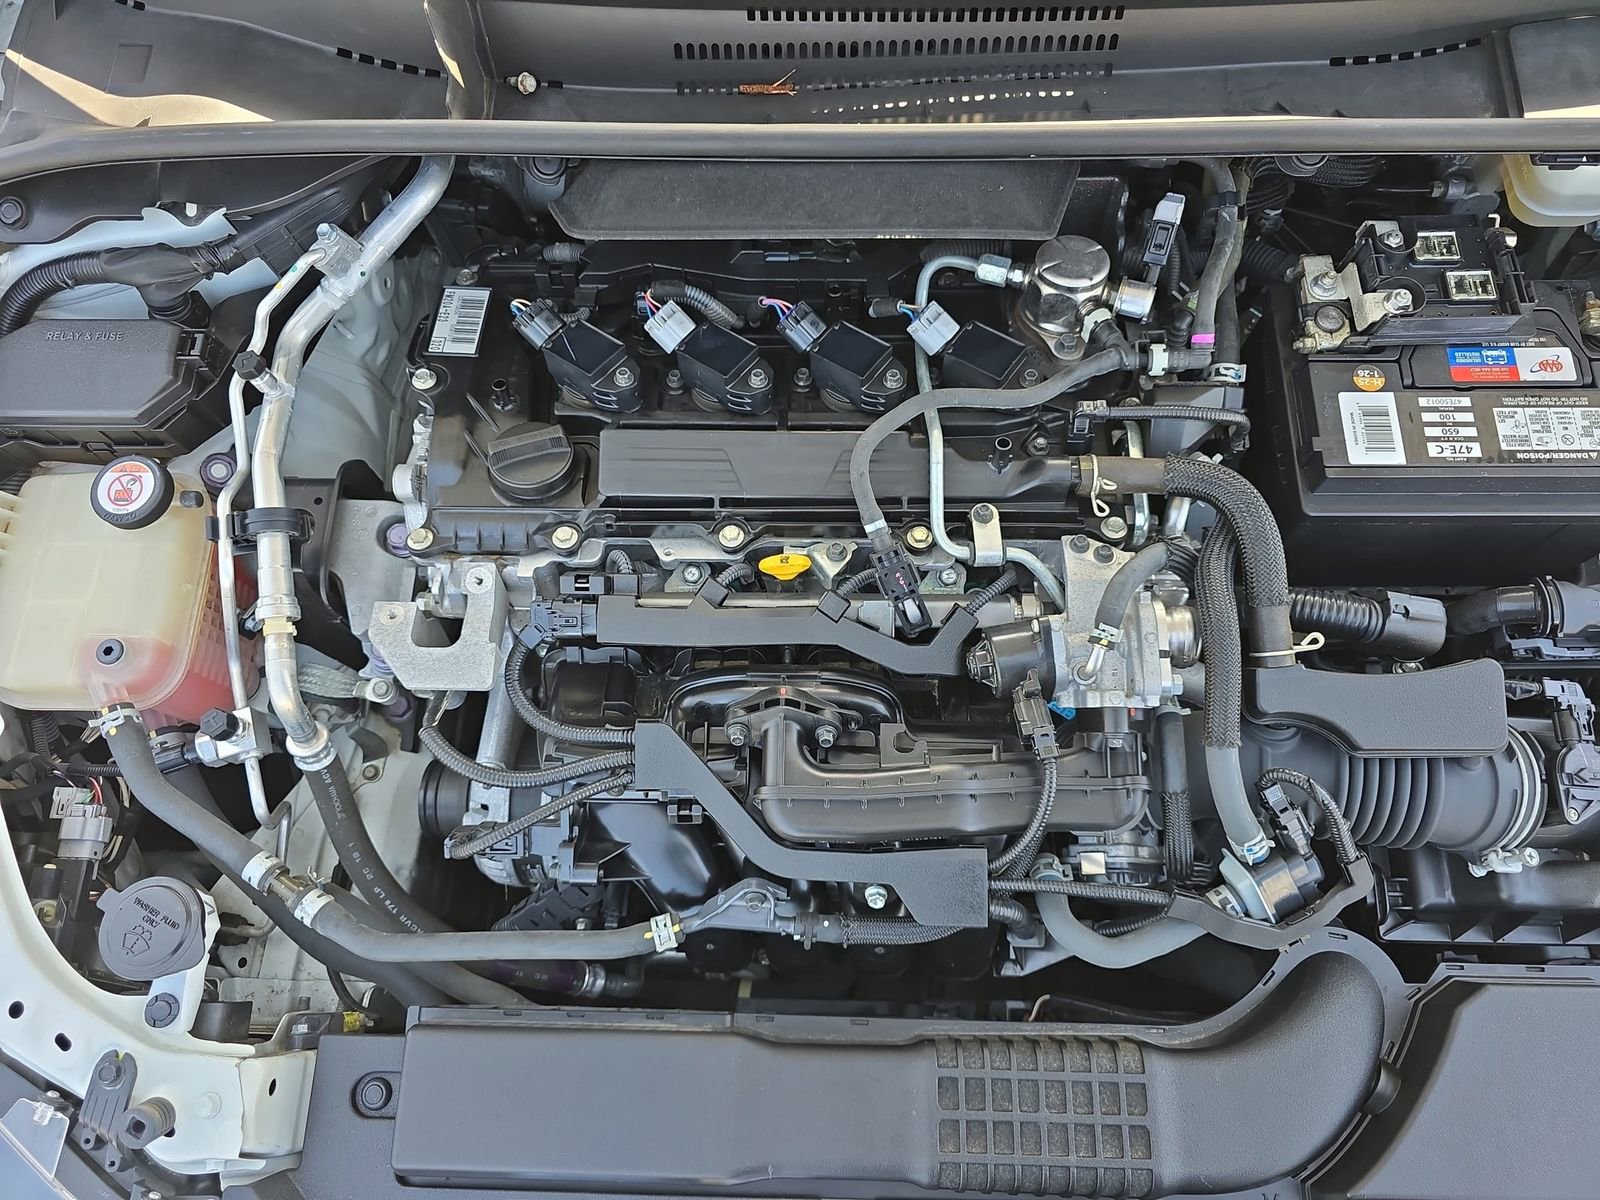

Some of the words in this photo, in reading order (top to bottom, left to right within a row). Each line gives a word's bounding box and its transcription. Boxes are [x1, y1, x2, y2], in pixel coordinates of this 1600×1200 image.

[46, 332, 82, 340] RELAY
[84, 332, 93, 340] &
[95, 332, 124, 340] FUSE
[1540, 360, 1560, 372] AAA
[1435, 444, 1473, 454] 47E-C
[104, 513, 137, 522] DENSO
[374, 886, 385, 899] LP
[133, 897, 160, 918] WASHER
[160, 914, 180, 930] FLUID
[142, 915, 160, 928] ONLY
